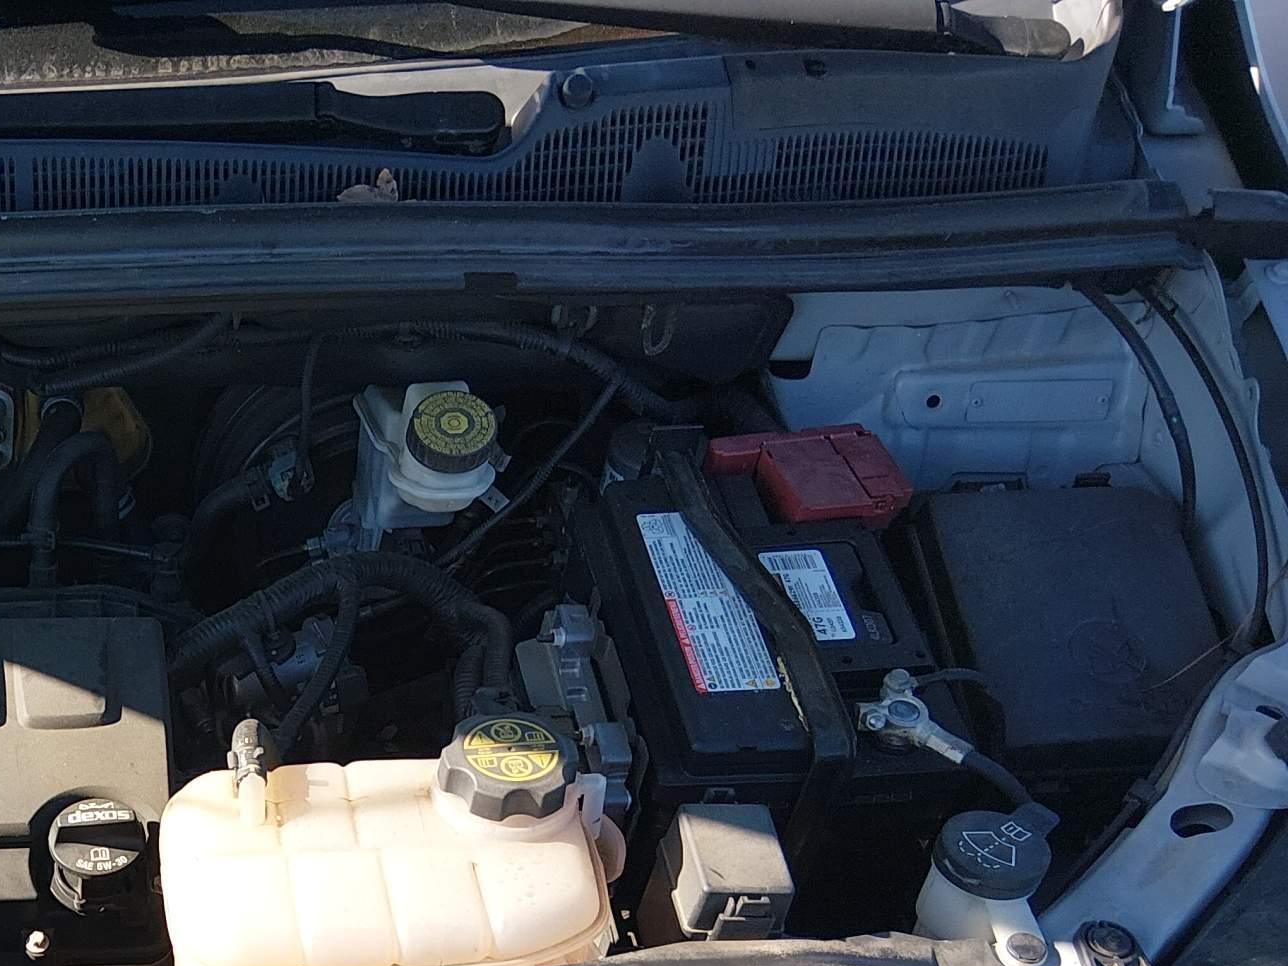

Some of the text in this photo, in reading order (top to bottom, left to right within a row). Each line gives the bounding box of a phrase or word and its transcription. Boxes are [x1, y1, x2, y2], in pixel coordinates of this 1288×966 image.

[812, 616, 828, 636] 47G
[67, 810, 130, 824] dexos
[75, 859, 94, 871] SAE
